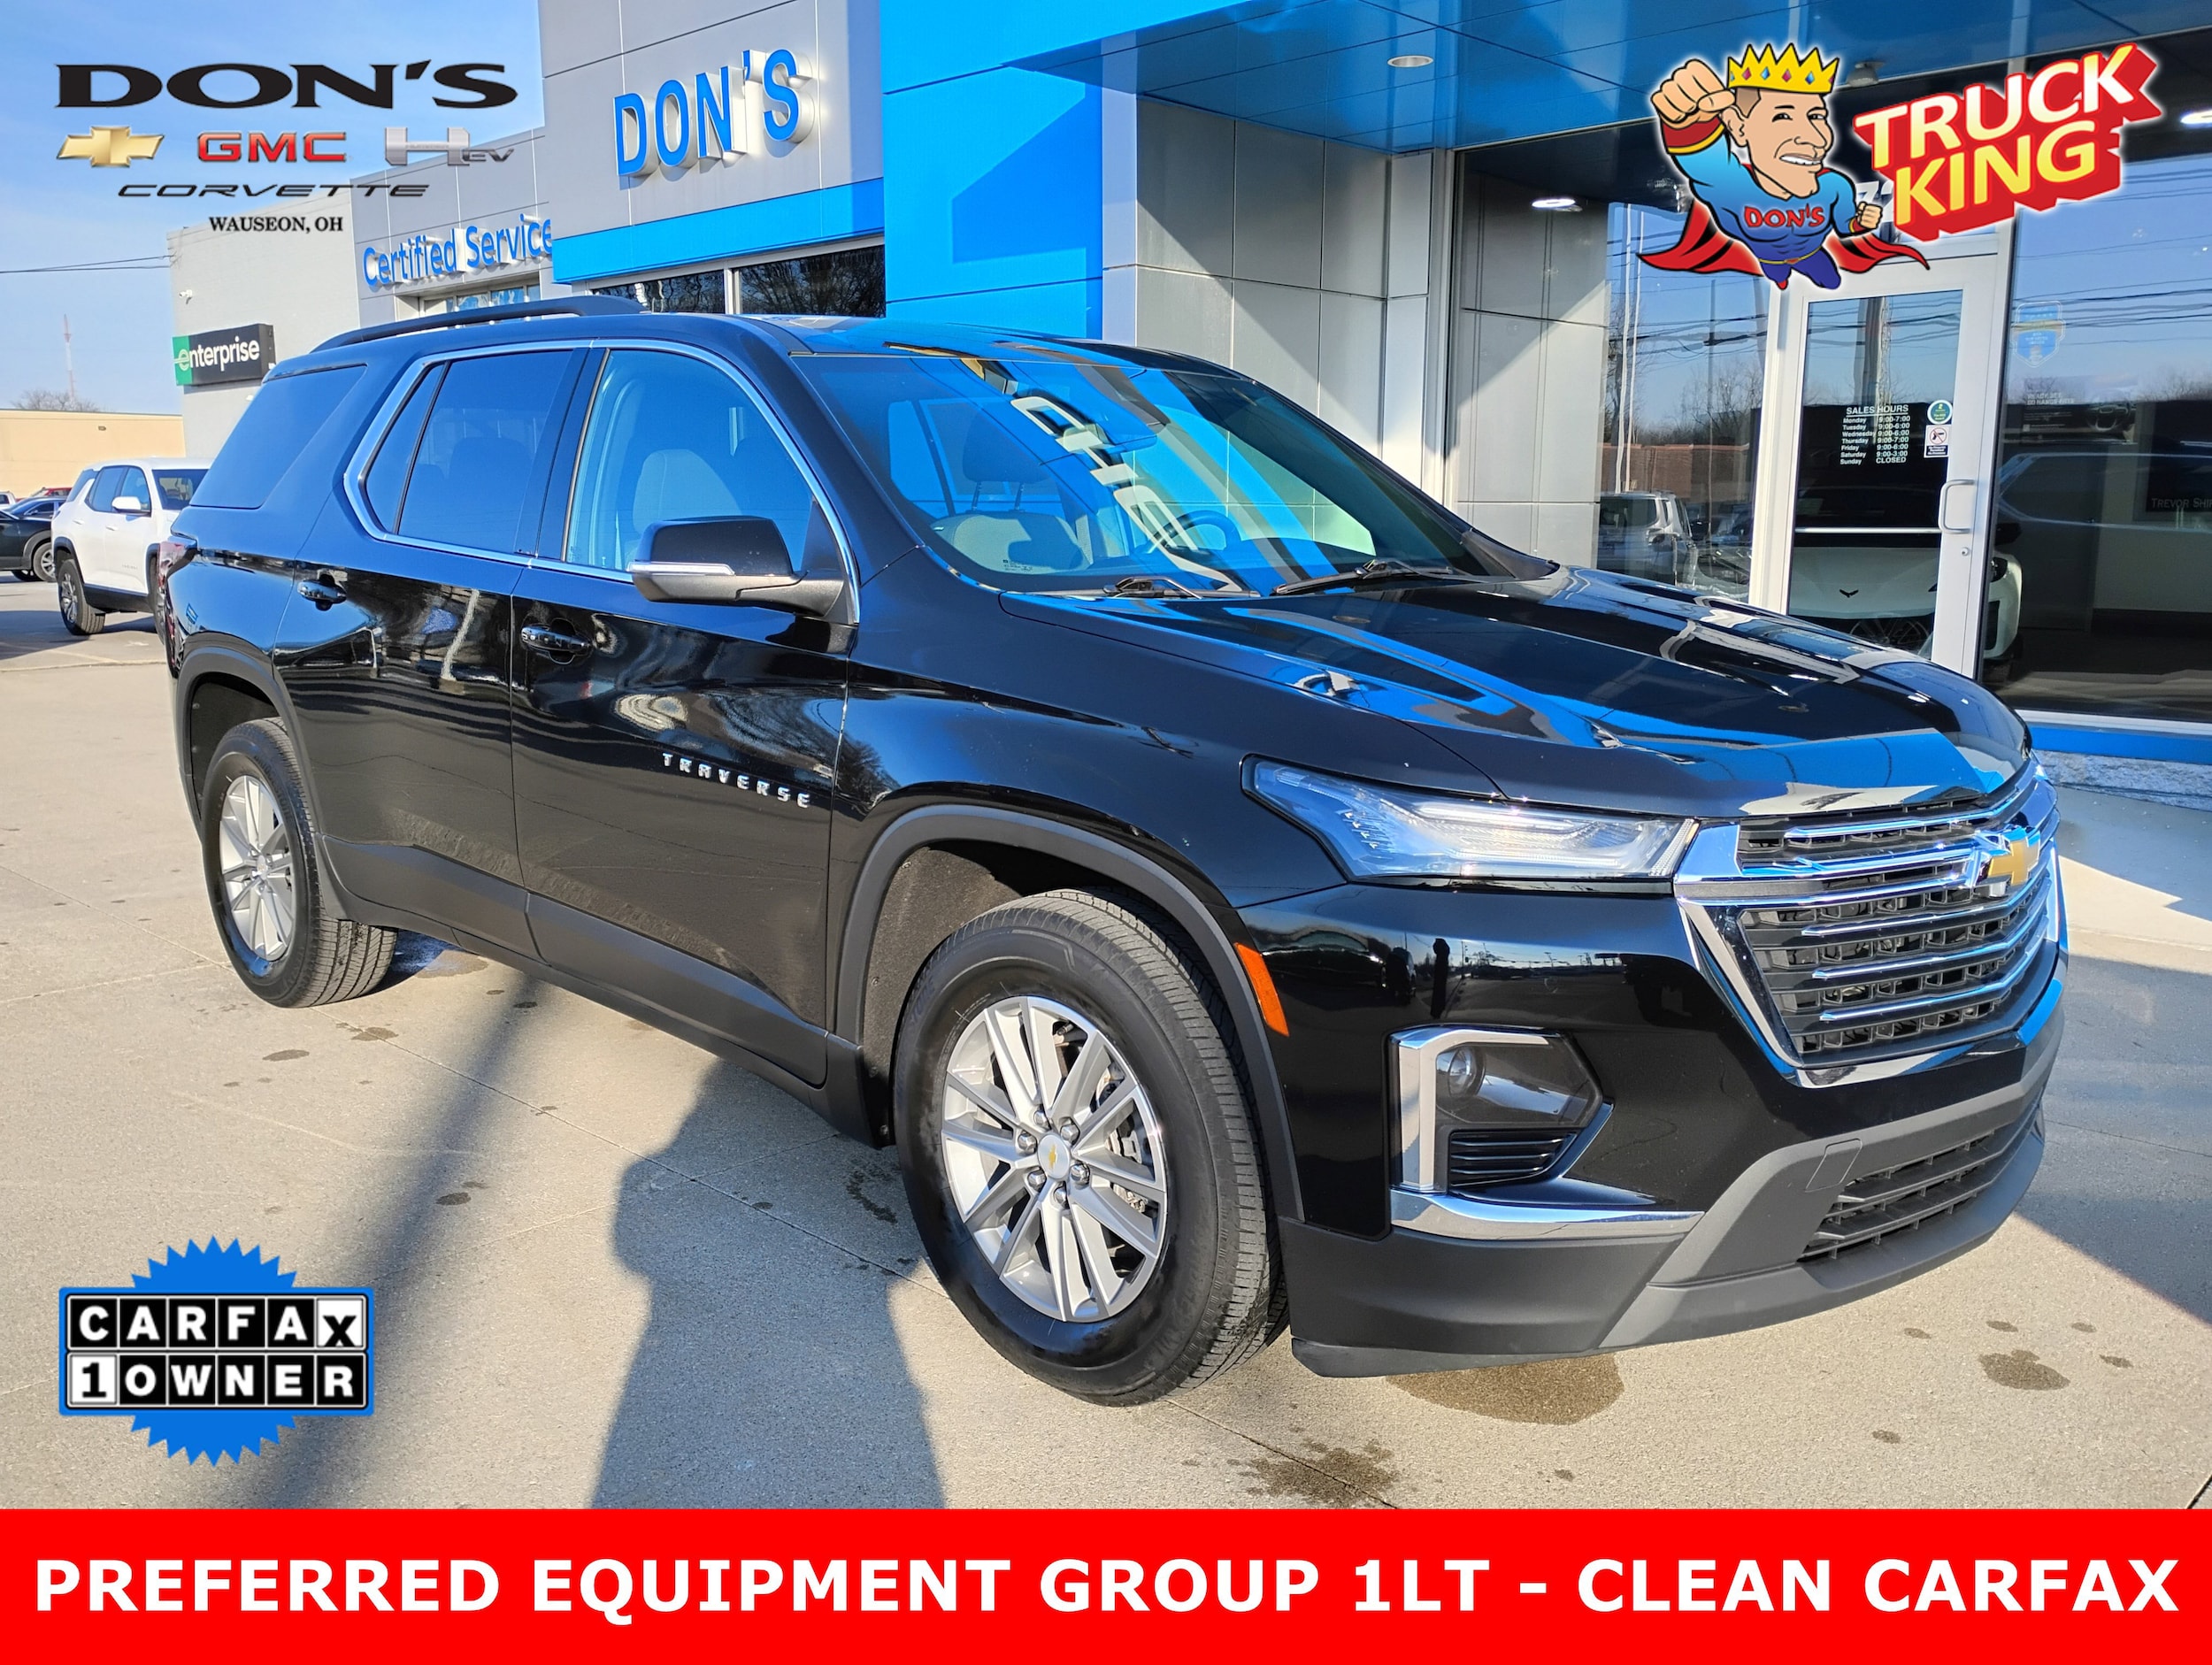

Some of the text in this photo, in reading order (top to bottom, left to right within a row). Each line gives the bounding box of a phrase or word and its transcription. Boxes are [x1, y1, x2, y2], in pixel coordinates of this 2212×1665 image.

[613, 49, 801, 176] DON'S
[363, 213, 553, 287] Certified Service
[175, 335, 260, 372] enterprise
[1846, 404, 1909, 415] SALES HOURS
[2151, 497, 2189, 509] TREVOR
[662, 752, 810, 809] TRAVERSE
